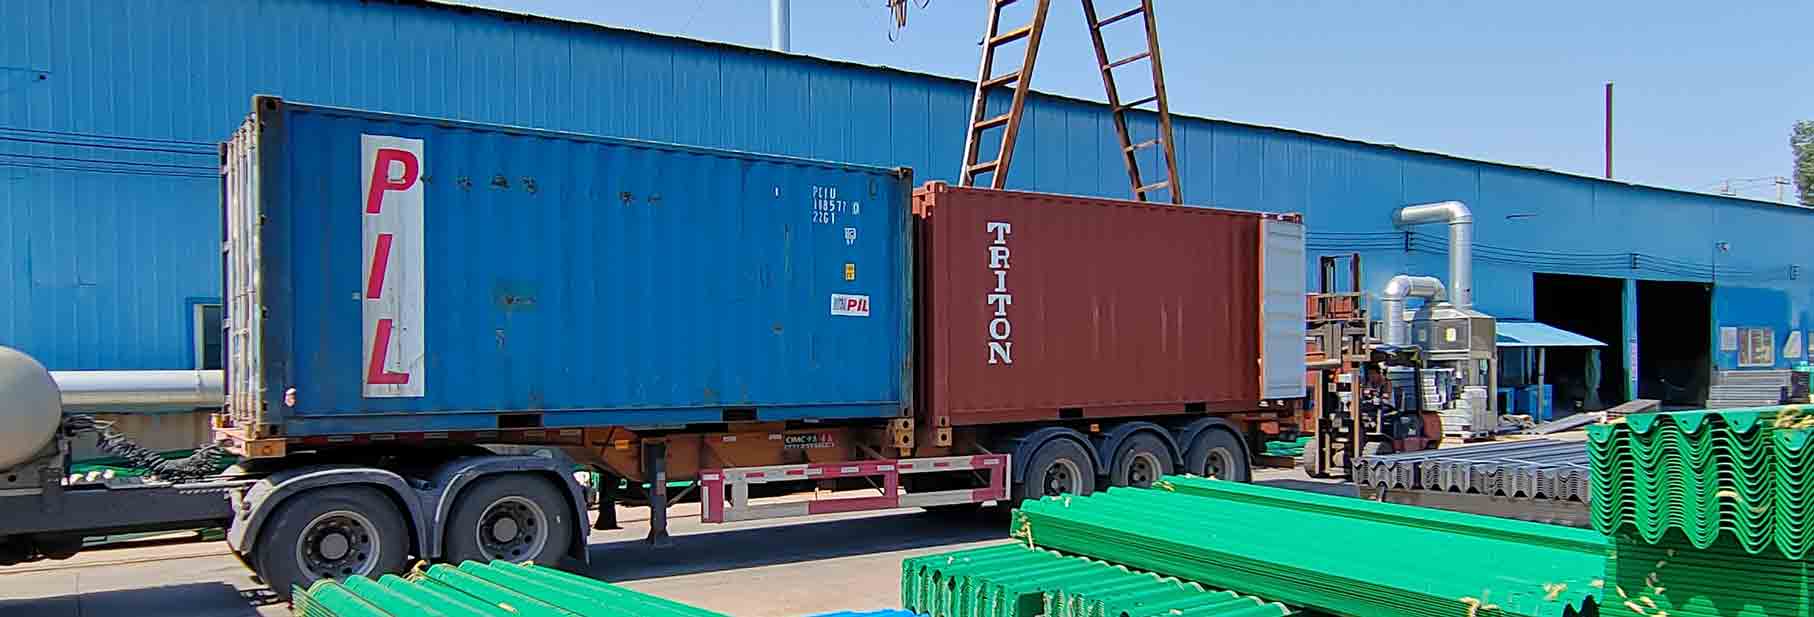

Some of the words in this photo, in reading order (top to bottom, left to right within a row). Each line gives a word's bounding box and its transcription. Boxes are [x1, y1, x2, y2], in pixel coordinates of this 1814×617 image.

[367, 148, 419, 385] PIL
[848, 299, 868, 312] PIL
[986, 222, 1013, 364] TRITON
